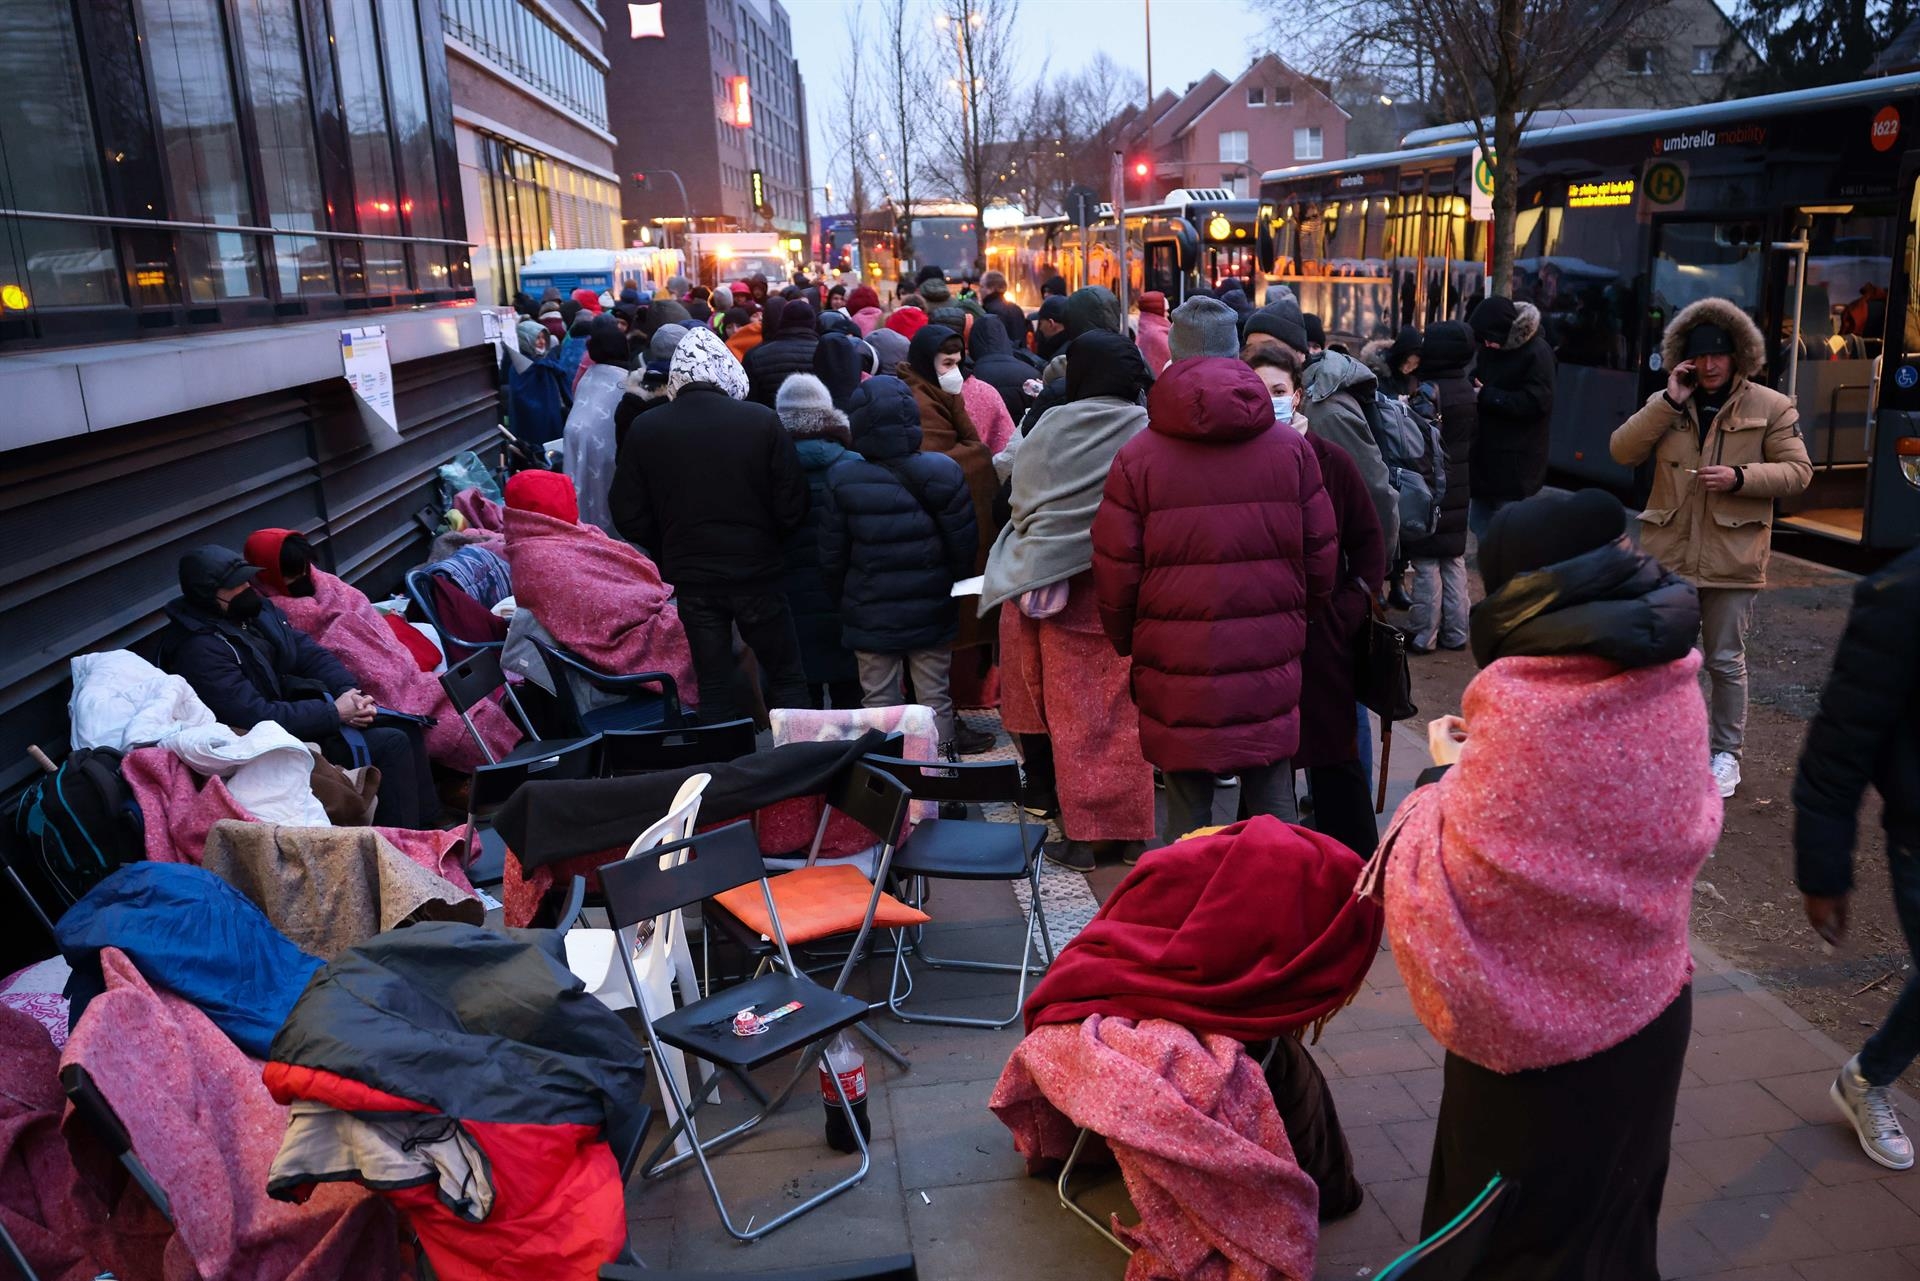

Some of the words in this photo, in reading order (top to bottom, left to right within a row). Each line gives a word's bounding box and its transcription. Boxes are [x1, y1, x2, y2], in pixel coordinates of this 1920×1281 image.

[1663, 130, 1716, 151] umbrella
[1717, 125, 1767, 145] mobility
[1873, 120, 1899, 136] 1622
